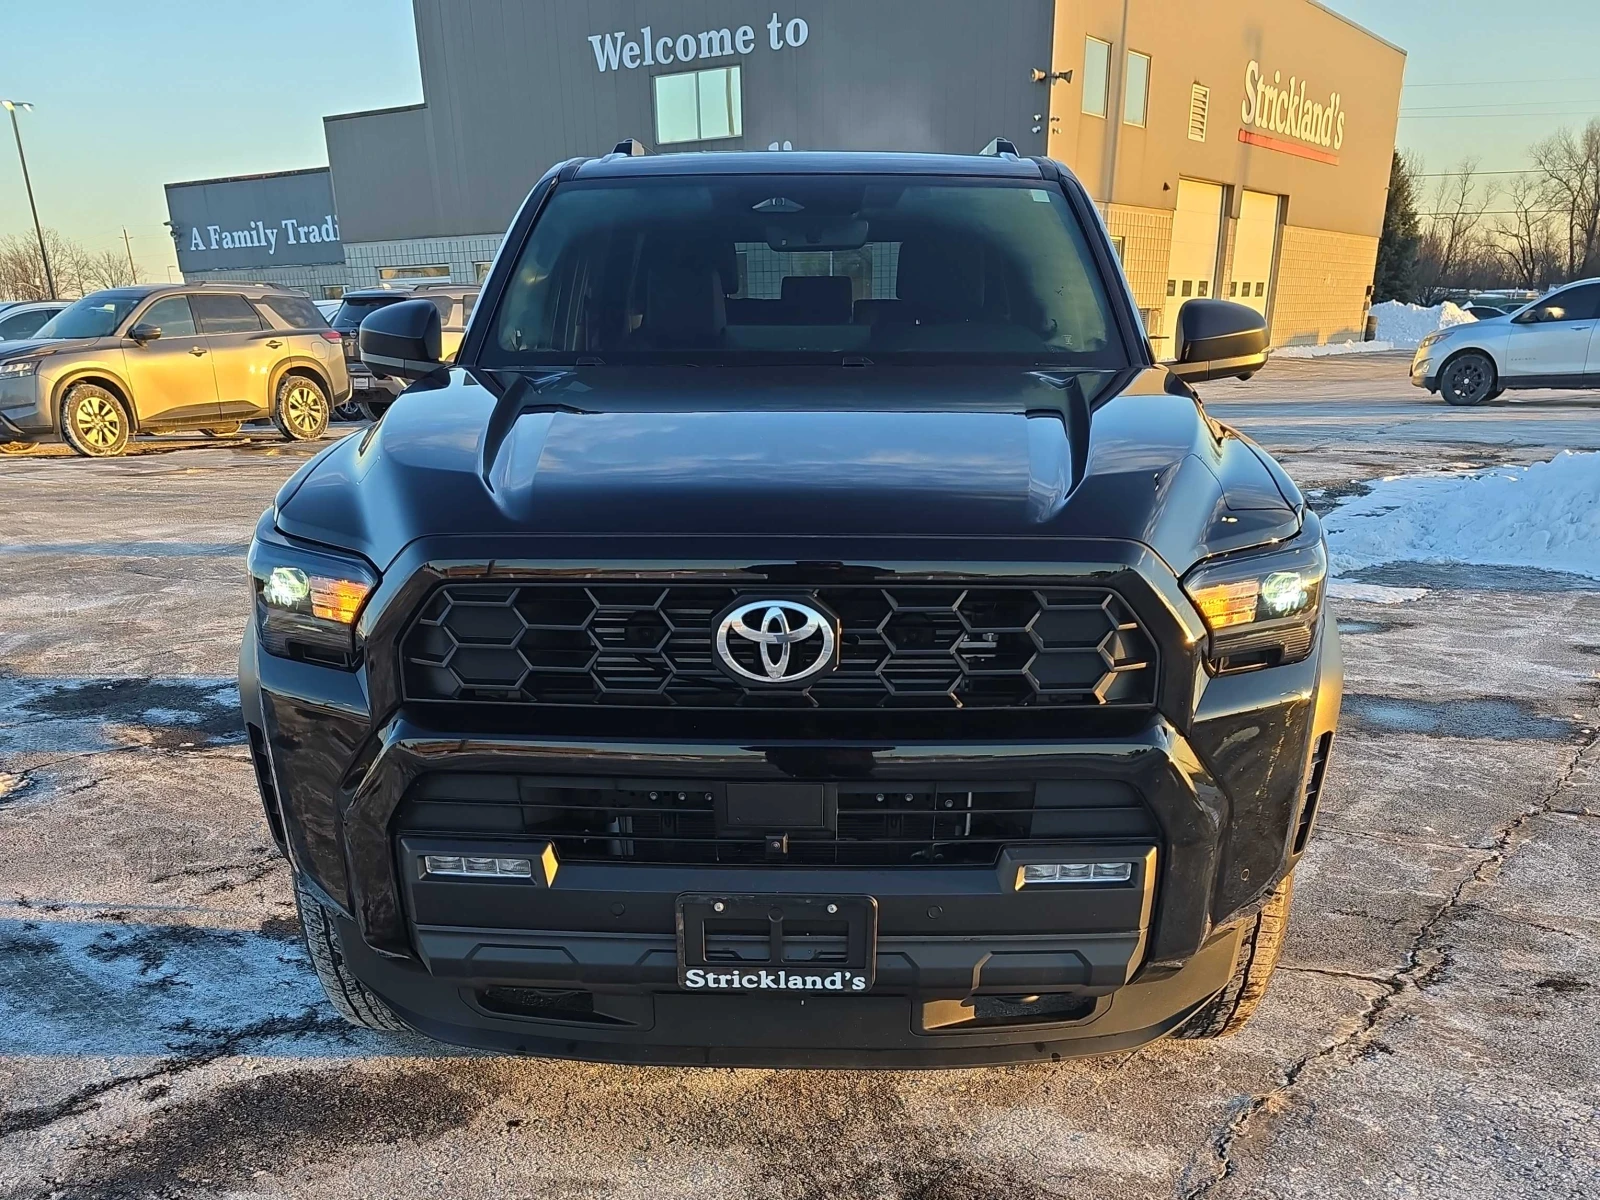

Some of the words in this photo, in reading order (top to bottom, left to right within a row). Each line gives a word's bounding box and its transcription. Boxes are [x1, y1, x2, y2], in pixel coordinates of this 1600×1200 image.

[587, 25, 756, 72] Welcome
[766, 12, 809, 51] to
[1241, 60, 1345, 150] Strickland's
[190, 227, 206, 251] A
[207, 220, 278, 255] Family
[685, 969, 866, 990] Strickland's
